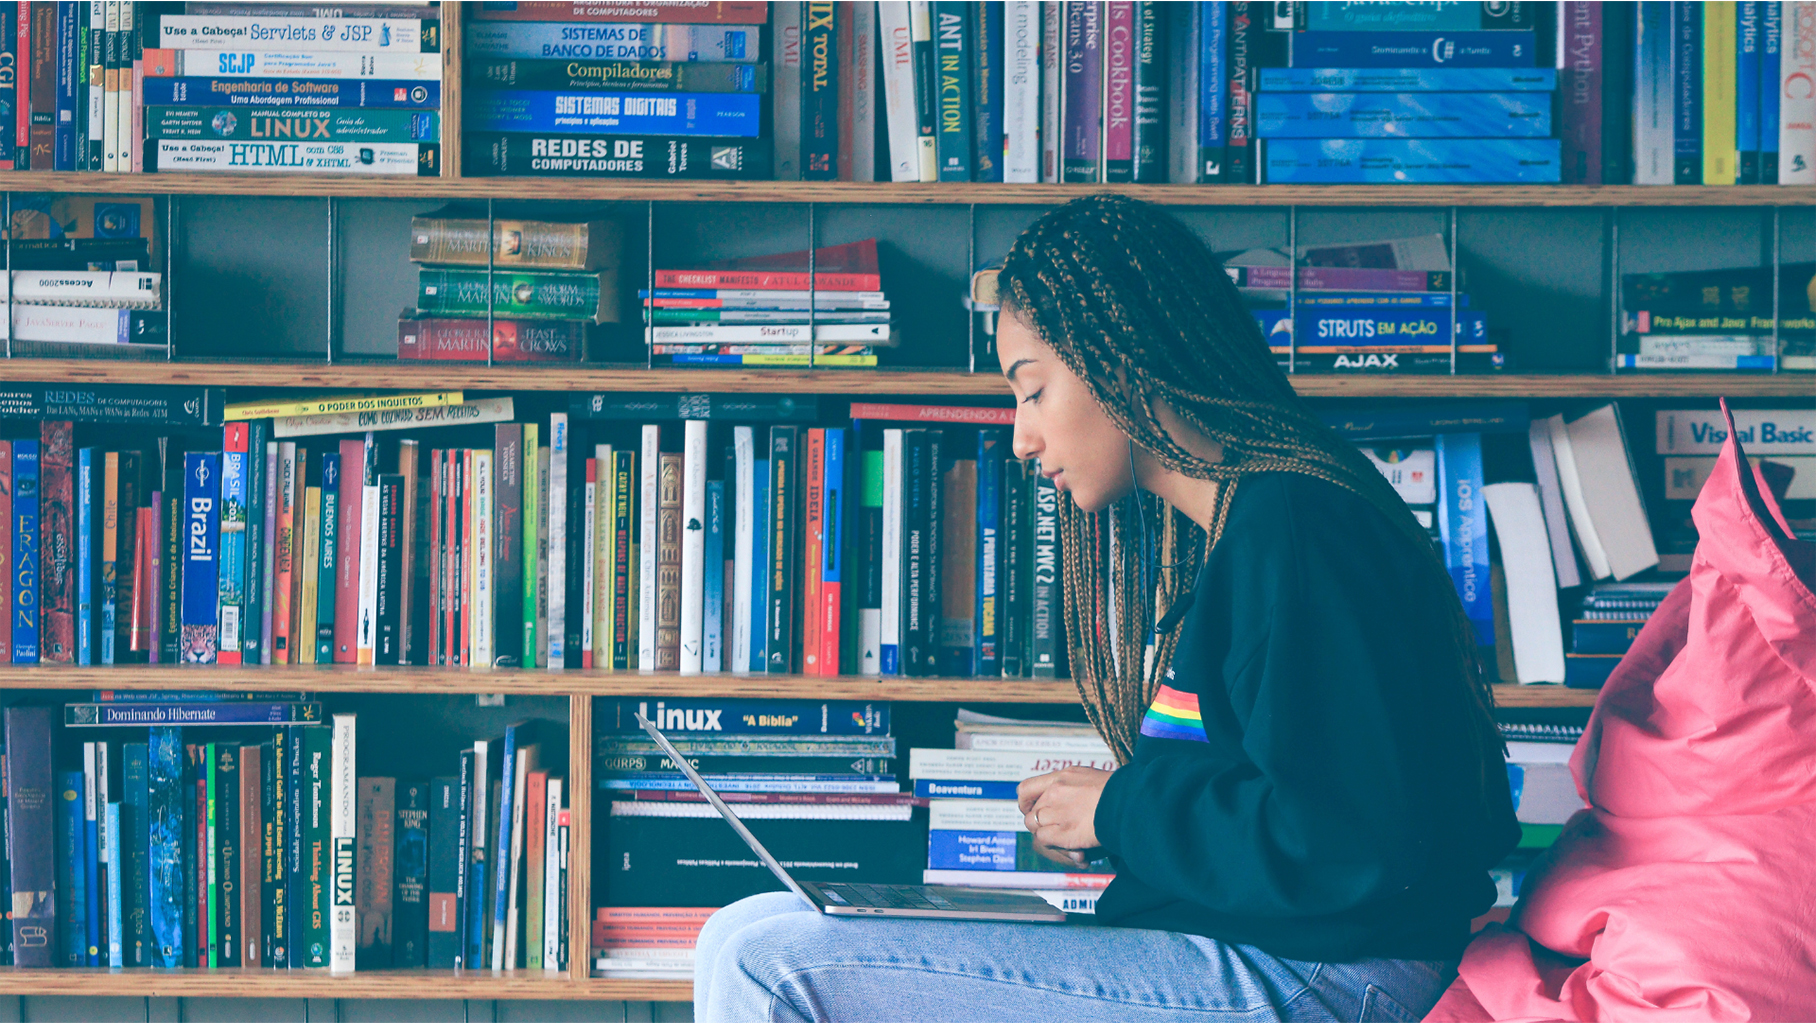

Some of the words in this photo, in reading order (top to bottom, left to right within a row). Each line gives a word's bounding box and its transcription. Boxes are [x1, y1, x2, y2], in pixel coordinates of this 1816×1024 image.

[572, 7, 584, 15] DE
[586, 7, 658, 17] COMPUTADORES
[1070, 1, 1084, 45] Beans
[1143, 9, 1155, 19] of
[80, 27, 88, 44] Zend
[93, 31, 101, 46] Third
[164, 26, 185, 36] Use
[190, 28, 197, 36] a
[201, 25, 247, 38] Cabeça!
[250, 24, 316, 41] Servlets
[322, 24, 337, 41] &
[340, 25, 373, 42] JSP
[561, 27, 625, 40] SISTEMAS
[628, 28, 647, 40] DE
[939, 13, 962, 51] ANT
[541, 44, 592, 58] BANCO
[596, 44, 614, 58] DE
[618, 44, 666, 59] DADOS
[1012, 14, 1032, 85] modeling
[1044, 28, 1057, 69] TEAMS
[1140, 22, 1155, 64] Strategy
[79, 45, 88, 83] Framework
[93, 46, 101, 65] Edition
[218, 53, 255, 73] SCJP
[813, 33, 828, 92] TOTAL
[942, 54, 960, 71] IN
[1068, 49, 1083, 73] 3.0
[0, 51, 14, 88] CGI
[567, 63, 673, 80] Compiladores
[1110, 26, 1130, 128] Cookbook
[1230, 20, 1249, 139] ANTIPATTERNS
[1570, 33, 1595, 104] Python
[212, 80, 272, 97] Engenharia
[275, 81, 288, 95] de
[298, 81, 339, 95] Software
[231, 95, 247, 107] Uma
[249, 95, 293, 108] Abordagem
[294, 95, 339, 107] Profissional
[555, 96, 621, 115] SISTEMAS
[624, 97, 677, 117] DIGITAIS
[941, 75, 961, 133] ACTION
[251, 110, 280, 118] MANUAL
[280, 110, 318, 118] COMPLETO
[320, 110, 331, 118] DO
[555, 116, 583, 127] princípios
[585, 117, 589, 126] e
[590, 117, 620, 128] aplicações
[250, 118, 330, 138] LINUX
[162, 145, 177, 153] Use
[190, 144, 224, 154] Cabeça!
[229, 144, 304, 166] HTML
[306, 146, 325, 155] com
[326, 145, 344, 155] CSS
[532, 139, 607, 158] REDES
[614, 140, 643, 159] DE
[667, 140, 677, 174] Gabriel
[678, 142, 688, 172] Torres
[317, 157, 351, 167] XHTML
[532, 159, 643, 172] COMPUTADORES
[39, 279, 94, 289] Access2000
[760, 326, 799, 338] Startup
[1317, 319, 1375, 338] STRUTS
[1377, 321, 1395, 335] EM
[1399, 319, 1438, 338] AÇÃO
[1333, 354, 1399, 368] AJAX
[44, 390, 96, 404] REDES
[98, 399, 107, 407] DE
[108, 398, 168, 408] COMPUTADORES
[327, 402, 356, 412] PODER
[358, 400, 376, 410] DOS
[377, 397, 423, 409] INQUIETOS
[555, 422, 566, 451] Fleury
[1691, 421, 1755, 444] Visal
[1760, 421, 1815, 445] Basic
[644, 470, 656, 481] A
[810, 447, 819, 482] GRANDE
[618, 472, 628, 494] CATHY
[912, 478, 920, 508] VIEIRA
[643, 482, 656, 518] Cauda
[807, 486, 819, 523] IDEIA
[1457, 478, 1473, 511] iOS
[105, 500, 118, 530] Chile
[324, 494, 335, 536] BUENOS
[617, 495, 627, 518] O'NEIL
[1037, 485, 1055, 543] ASP.NET
[169, 498, 178, 542] Adolescente
[190, 497, 213, 561] Brazil
[642, 520, 655, 554] Longa
[910, 530, 921, 554] PODER
[983, 528, 996, 536] A
[1010, 530, 1017, 541] IN
[168, 544, 177, 554] do
[323, 538, 333, 569] AIRES
[616, 530, 627, 563] WEAPONS
[616, 565, 627, 574] OF
[910, 561, 920, 578] ALTA
[983, 536, 996, 596] PRIVATARIA
[1036, 545, 1055, 574] MVC
[1459, 515, 1478, 602] Apprentice
[17, 514, 37, 628] ERAGON
[168, 562, 179, 589] Criança
[642, 560, 653, 582] Chris
[1036, 575, 1055, 584] 2
[168, 591, 177, 600] da
[616, 576, 627, 595] MATH
[1036, 585, 1050, 597] IN
[641, 585, 652, 622] Anderson
[910, 579, 920, 632] PERFORMANCE
[168, 601, 177, 633] Estatuto
[615, 596, 627, 643] DESTRUCTION
[983, 595, 995, 637] TUCANA
[1035, 597, 1050, 639] ACTION
[106, 707, 166, 722] Dominando
[168, 706, 216, 721] Hibernate
[640, 701, 723, 731] Linux
[821, 703, 829, 733] Danesh
[275, 732, 284, 746] The
[275, 747, 284, 779] Advanced
[310, 751, 322, 779] Roger
[275, 779, 285, 799] Guide
[929, 782, 982, 795] Boaventura
[275, 800, 284, 809] to
[312, 780, 322, 829] Tomlinson
[398, 809, 428, 821] STEPHEN
[275, 809, 284, 826] Real
[375, 809, 391, 843] DAN
[404, 818, 421, 829] KING
[275, 826, 284, 847] Estate
[958, 834, 991, 845] Howard
[991, 835, 1017, 845] Anton
[274, 848, 284, 880] Investing
[310, 838, 322, 882] Thinking
[959, 853, 992, 865] Stephen
[992, 854, 1015, 865] Davis
[336, 838, 353, 905] LINUX
[374, 844, 391, 903] BROWN
[312, 882, 321, 910] About
[312, 910, 321, 929] GIS
